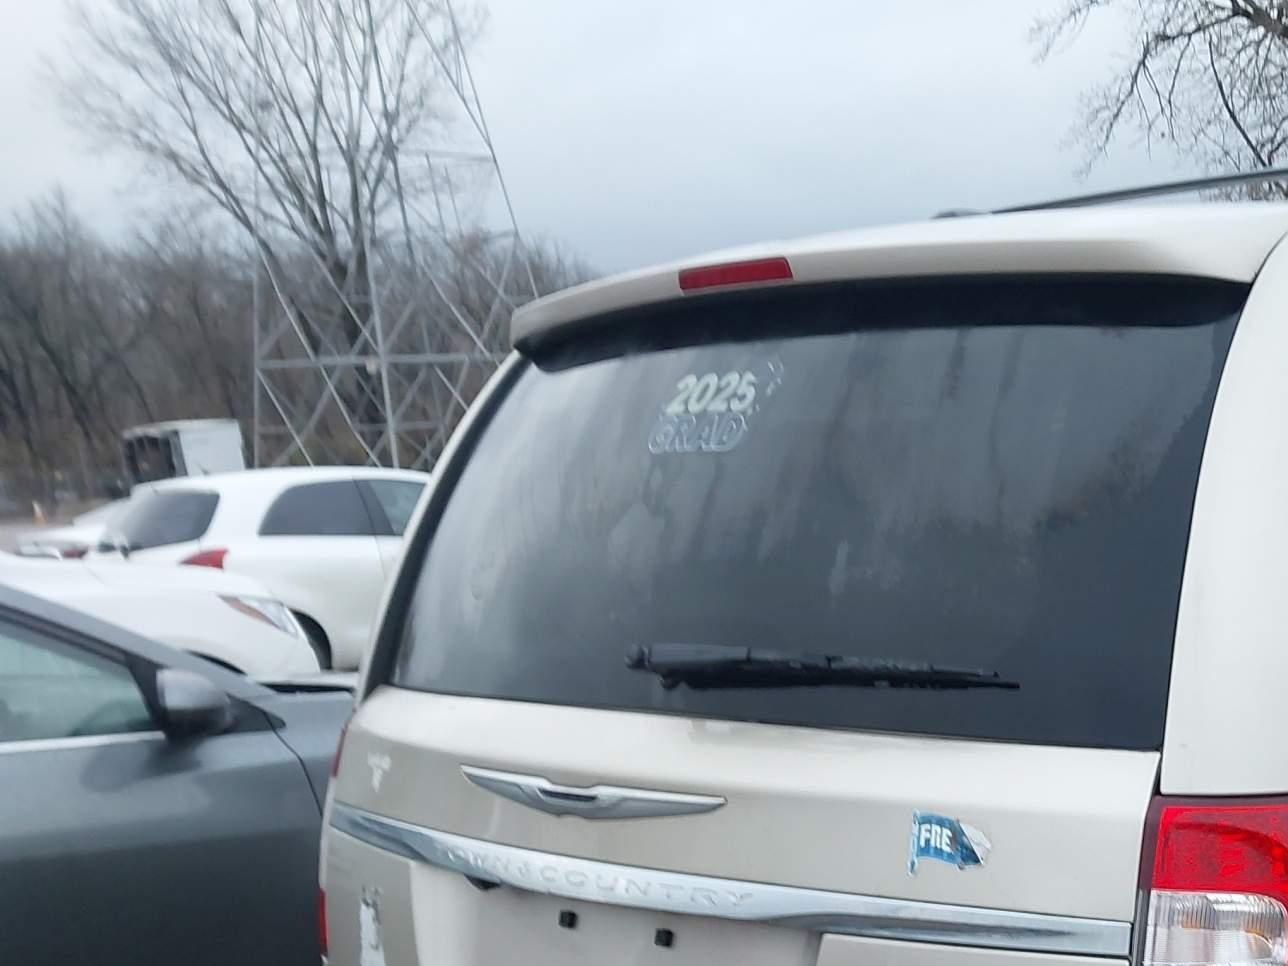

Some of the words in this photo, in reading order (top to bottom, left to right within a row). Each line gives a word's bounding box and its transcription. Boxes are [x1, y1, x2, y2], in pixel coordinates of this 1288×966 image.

[665, 370, 757, 415] 2025
[648, 414, 748, 455] GRAD
[539, 866, 755, 908] COUNTRY
